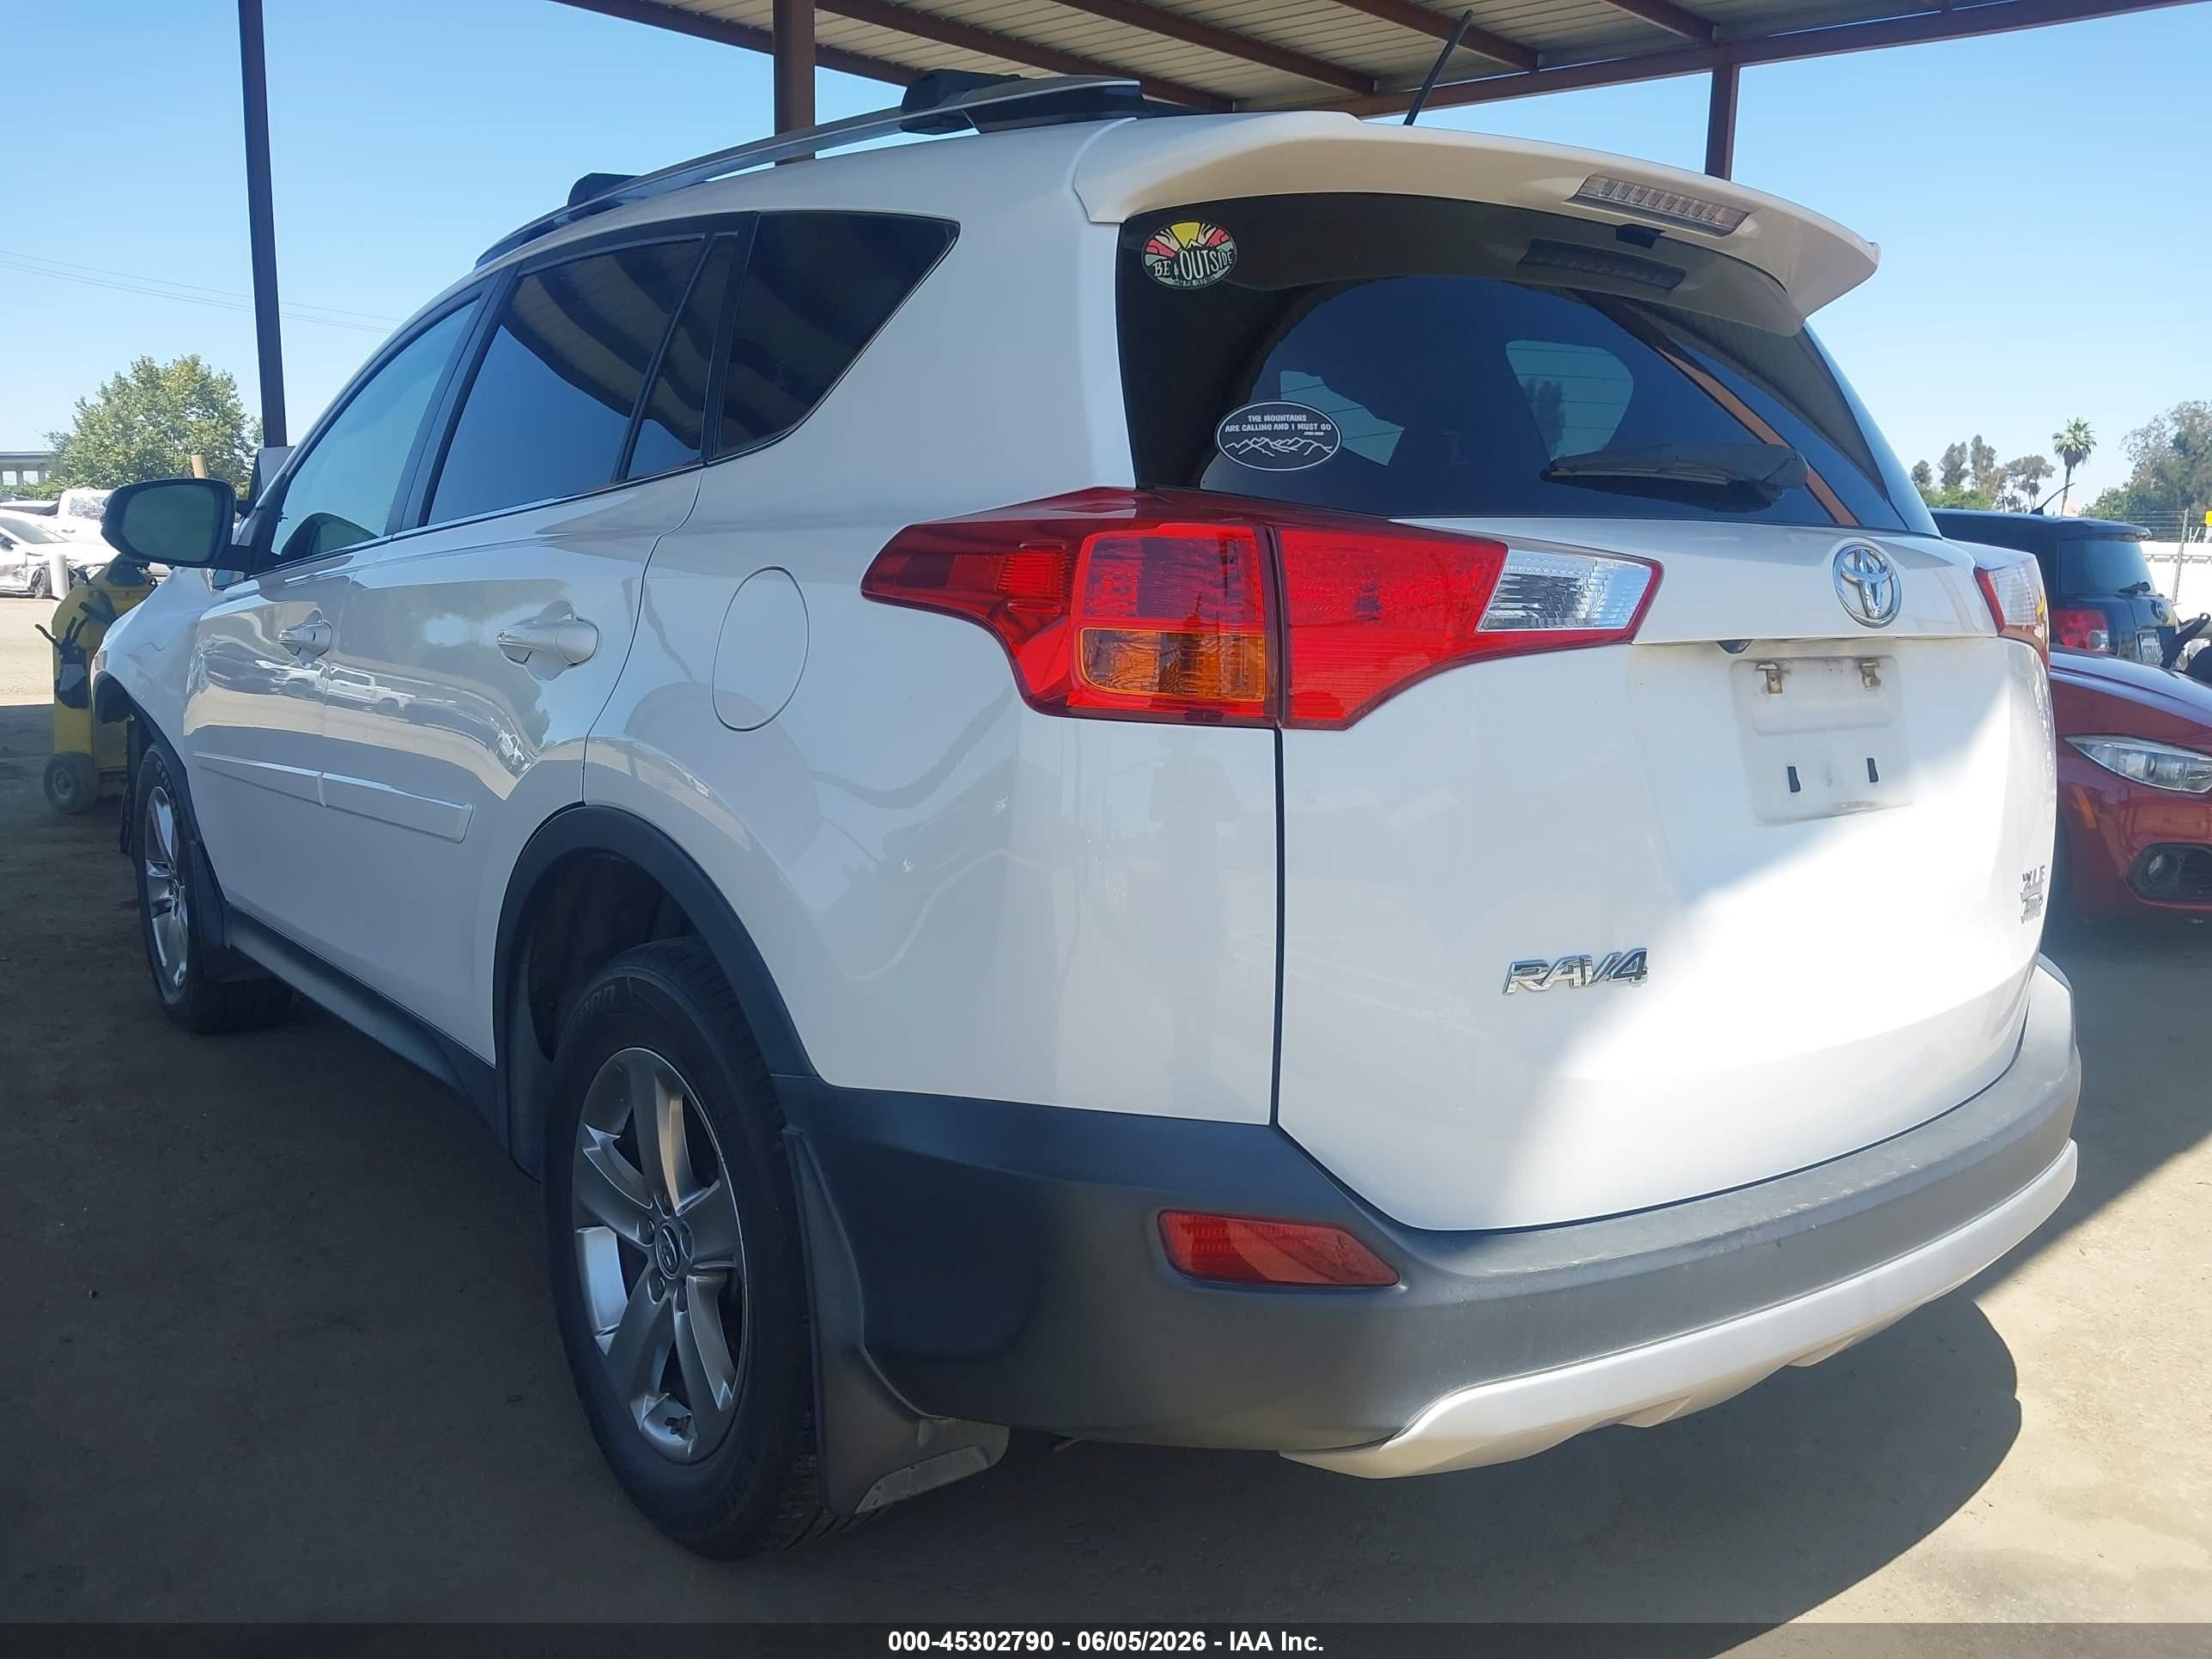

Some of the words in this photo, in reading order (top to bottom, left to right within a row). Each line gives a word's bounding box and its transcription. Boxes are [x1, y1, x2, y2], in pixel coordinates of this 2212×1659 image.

[1153, 260, 1171, 276] BE
[1179, 250, 1233, 280] OUTSIDE
[1224, 424, 1240, 433] ARE
[1242, 423, 1273, 432] CALLING
[1263, 414, 1307, 422] MOUNTAINS
[1502, 946, 1649, 995] RAV4
